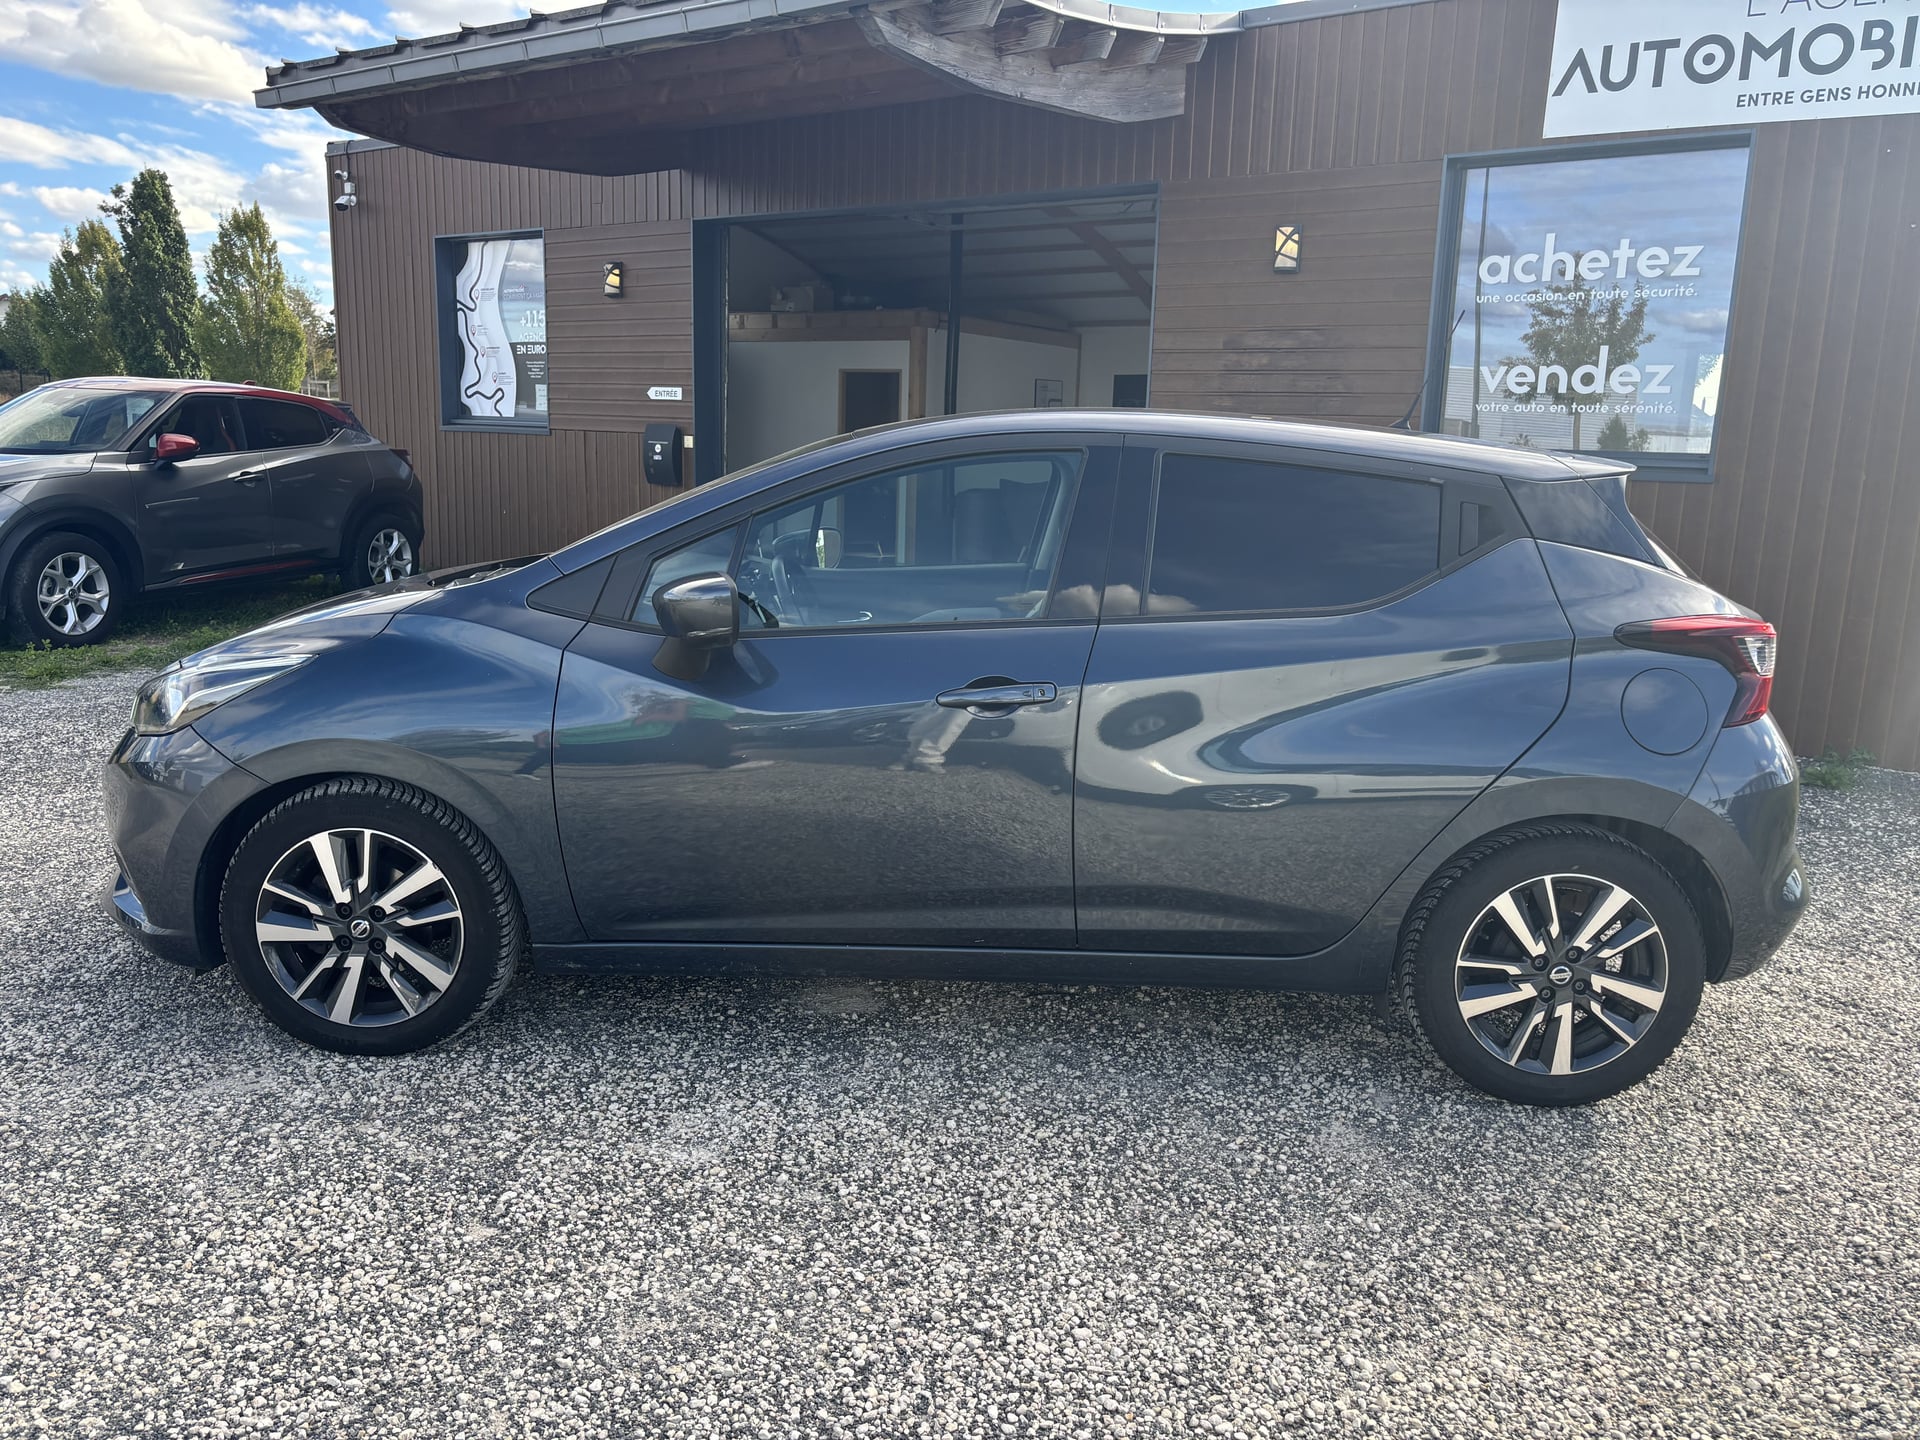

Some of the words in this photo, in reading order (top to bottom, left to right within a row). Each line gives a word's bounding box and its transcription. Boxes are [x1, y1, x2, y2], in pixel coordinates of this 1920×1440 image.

[1552, 16, 1920, 97] AUTOMOBI
[1736, 90, 1795, 108] ENTRE
[1800, 86, 1852, 104] GENS
[1478, 232, 1705, 285] achetez
[1476, 293, 1501, 304] une
[1504, 289, 1563, 302] occasion
[1567, 291, 1585, 301] en
[1590, 287, 1628, 300] toute
[1634, 282, 1699, 299] sécurité.
[1479, 345, 1676, 395] vendez
[654, 389, 678, 398] ENTRÉE
[1475, 402, 1510, 413] votre
[1513, 402, 1545, 413] auto
[1549, 404, 1566, 413] en
[1570, 401, 1609, 414] toute
[1613, 401, 1677, 414] sérénité.
